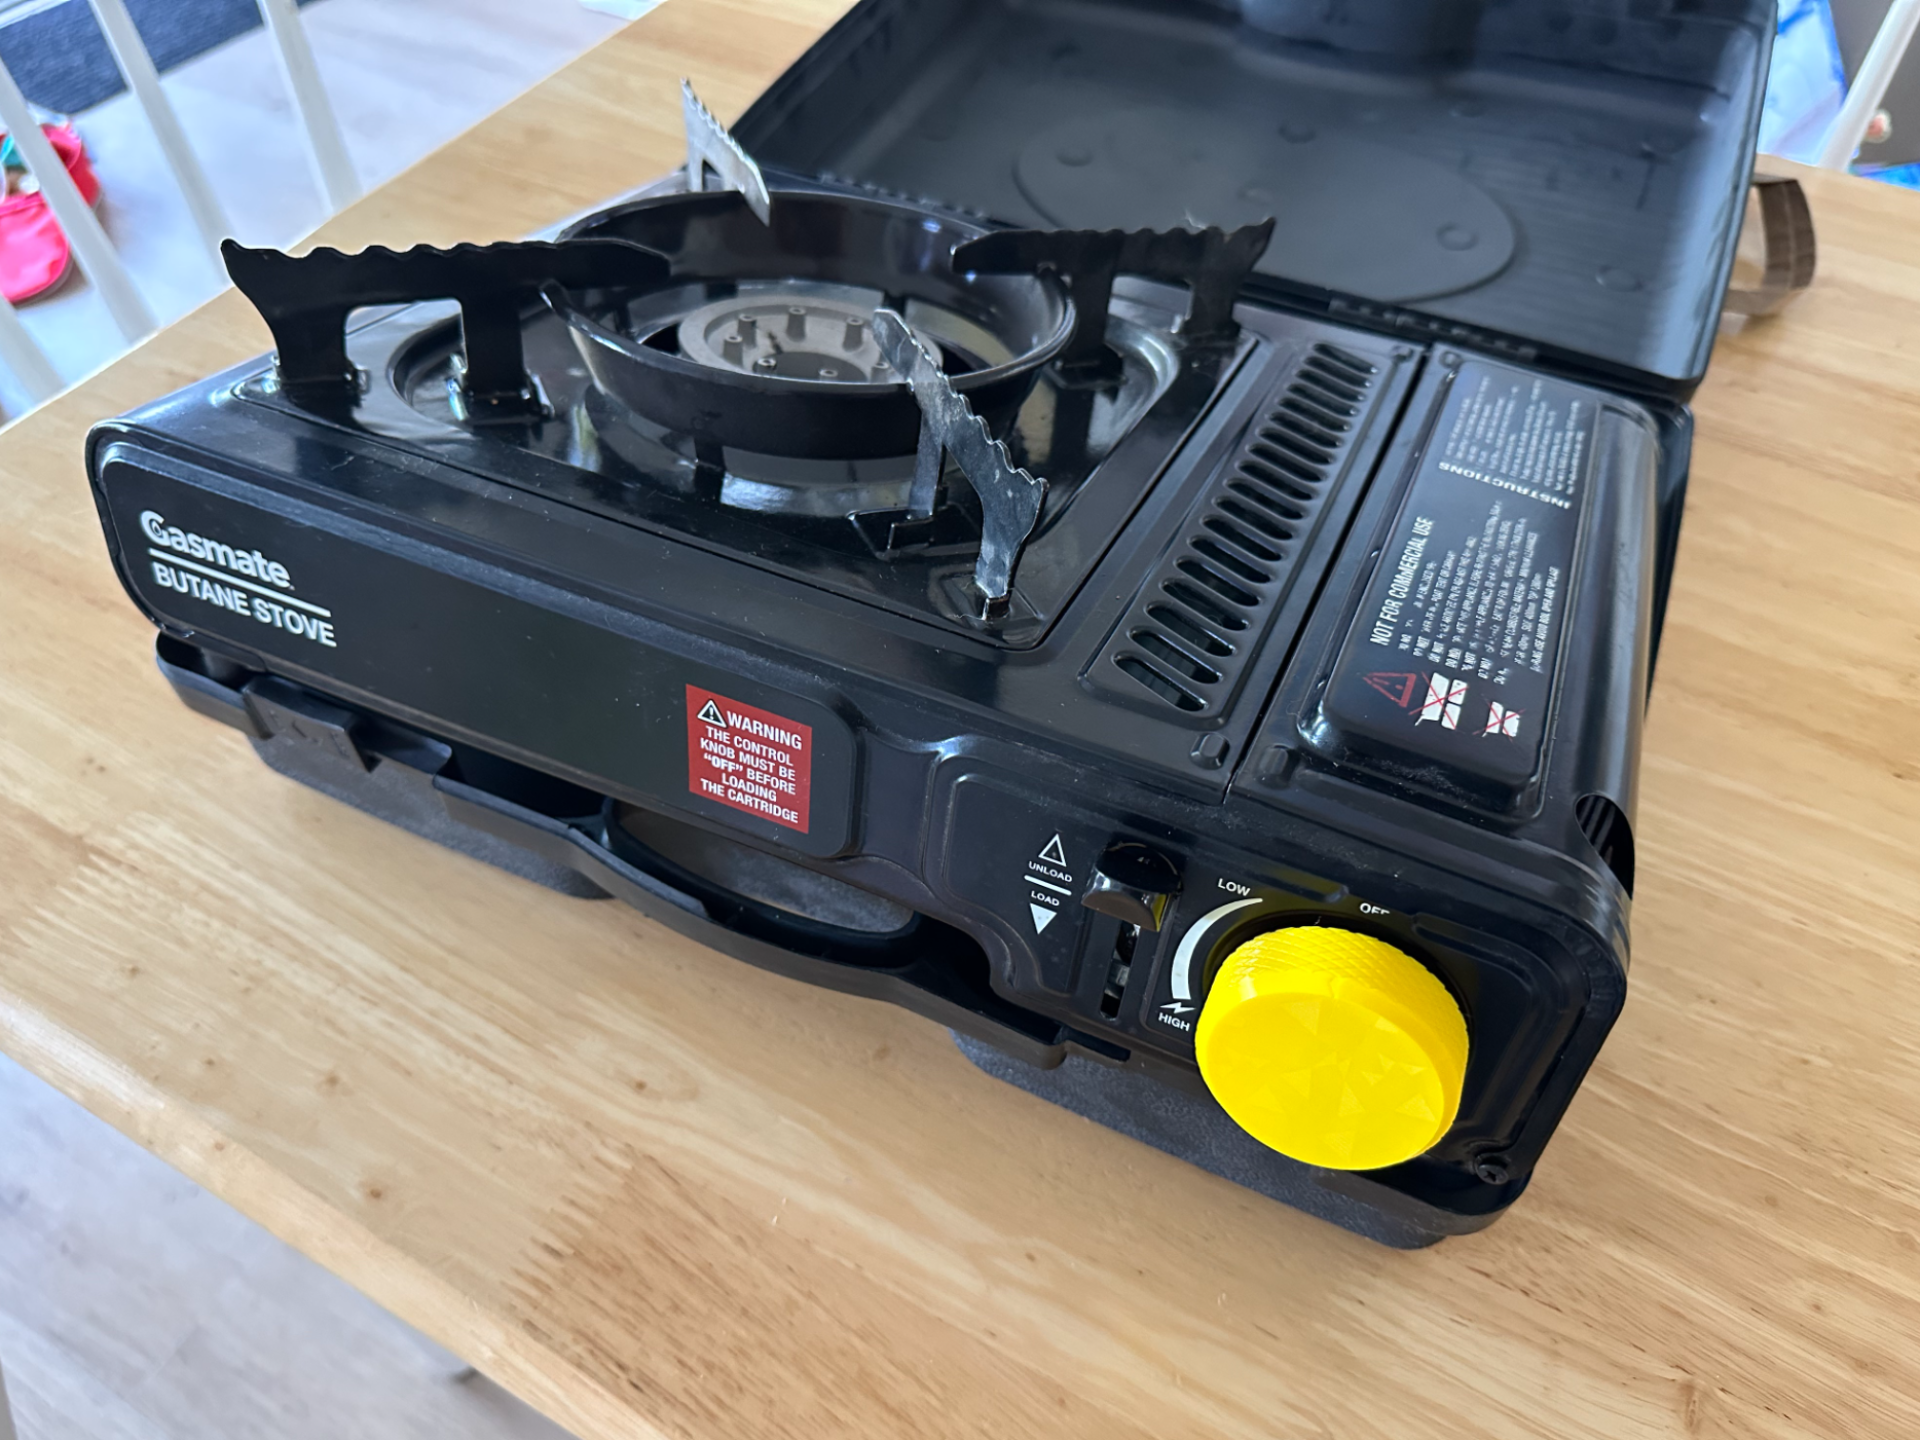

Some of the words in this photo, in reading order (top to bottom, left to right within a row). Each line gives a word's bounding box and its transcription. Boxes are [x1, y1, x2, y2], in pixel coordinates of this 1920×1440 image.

[1438, 461, 1573, 510] INSTRUCTIONS
[1411, 516, 1436, 537] USE
[140, 510, 291, 588] Gasmate
[1388, 537, 1429, 600] COMMERCIAL
[151, 561, 251, 616] BUTANE
[252, 597, 338, 647] STOVE
[1379, 598, 1404, 624] FOR
[1369, 620, 1395, 646] NOT
[727, 710, 802, 750] WARNING
[700, 737, 736, 759] KNOB
[739, 752, 775, 773] MUST
[779, 765, 796, 781] BE
[706, 725, 730, 744] THE
[733, 735, 794, 767] CONTROL
[722, 772, 777, 802] LOADING
[747, 768, 796, 795] BEFORE
[700, 778, 725, 797] THE
[728, 788, 798, 823] CARTRIDGE
[1028, 861, 1073, 884] UNLOAD
[1217, 877, 1251, 897] LOW
[1031, 890, 1060, 907] LOAD
[1158, 1012, 1191, 1032] HIGH
